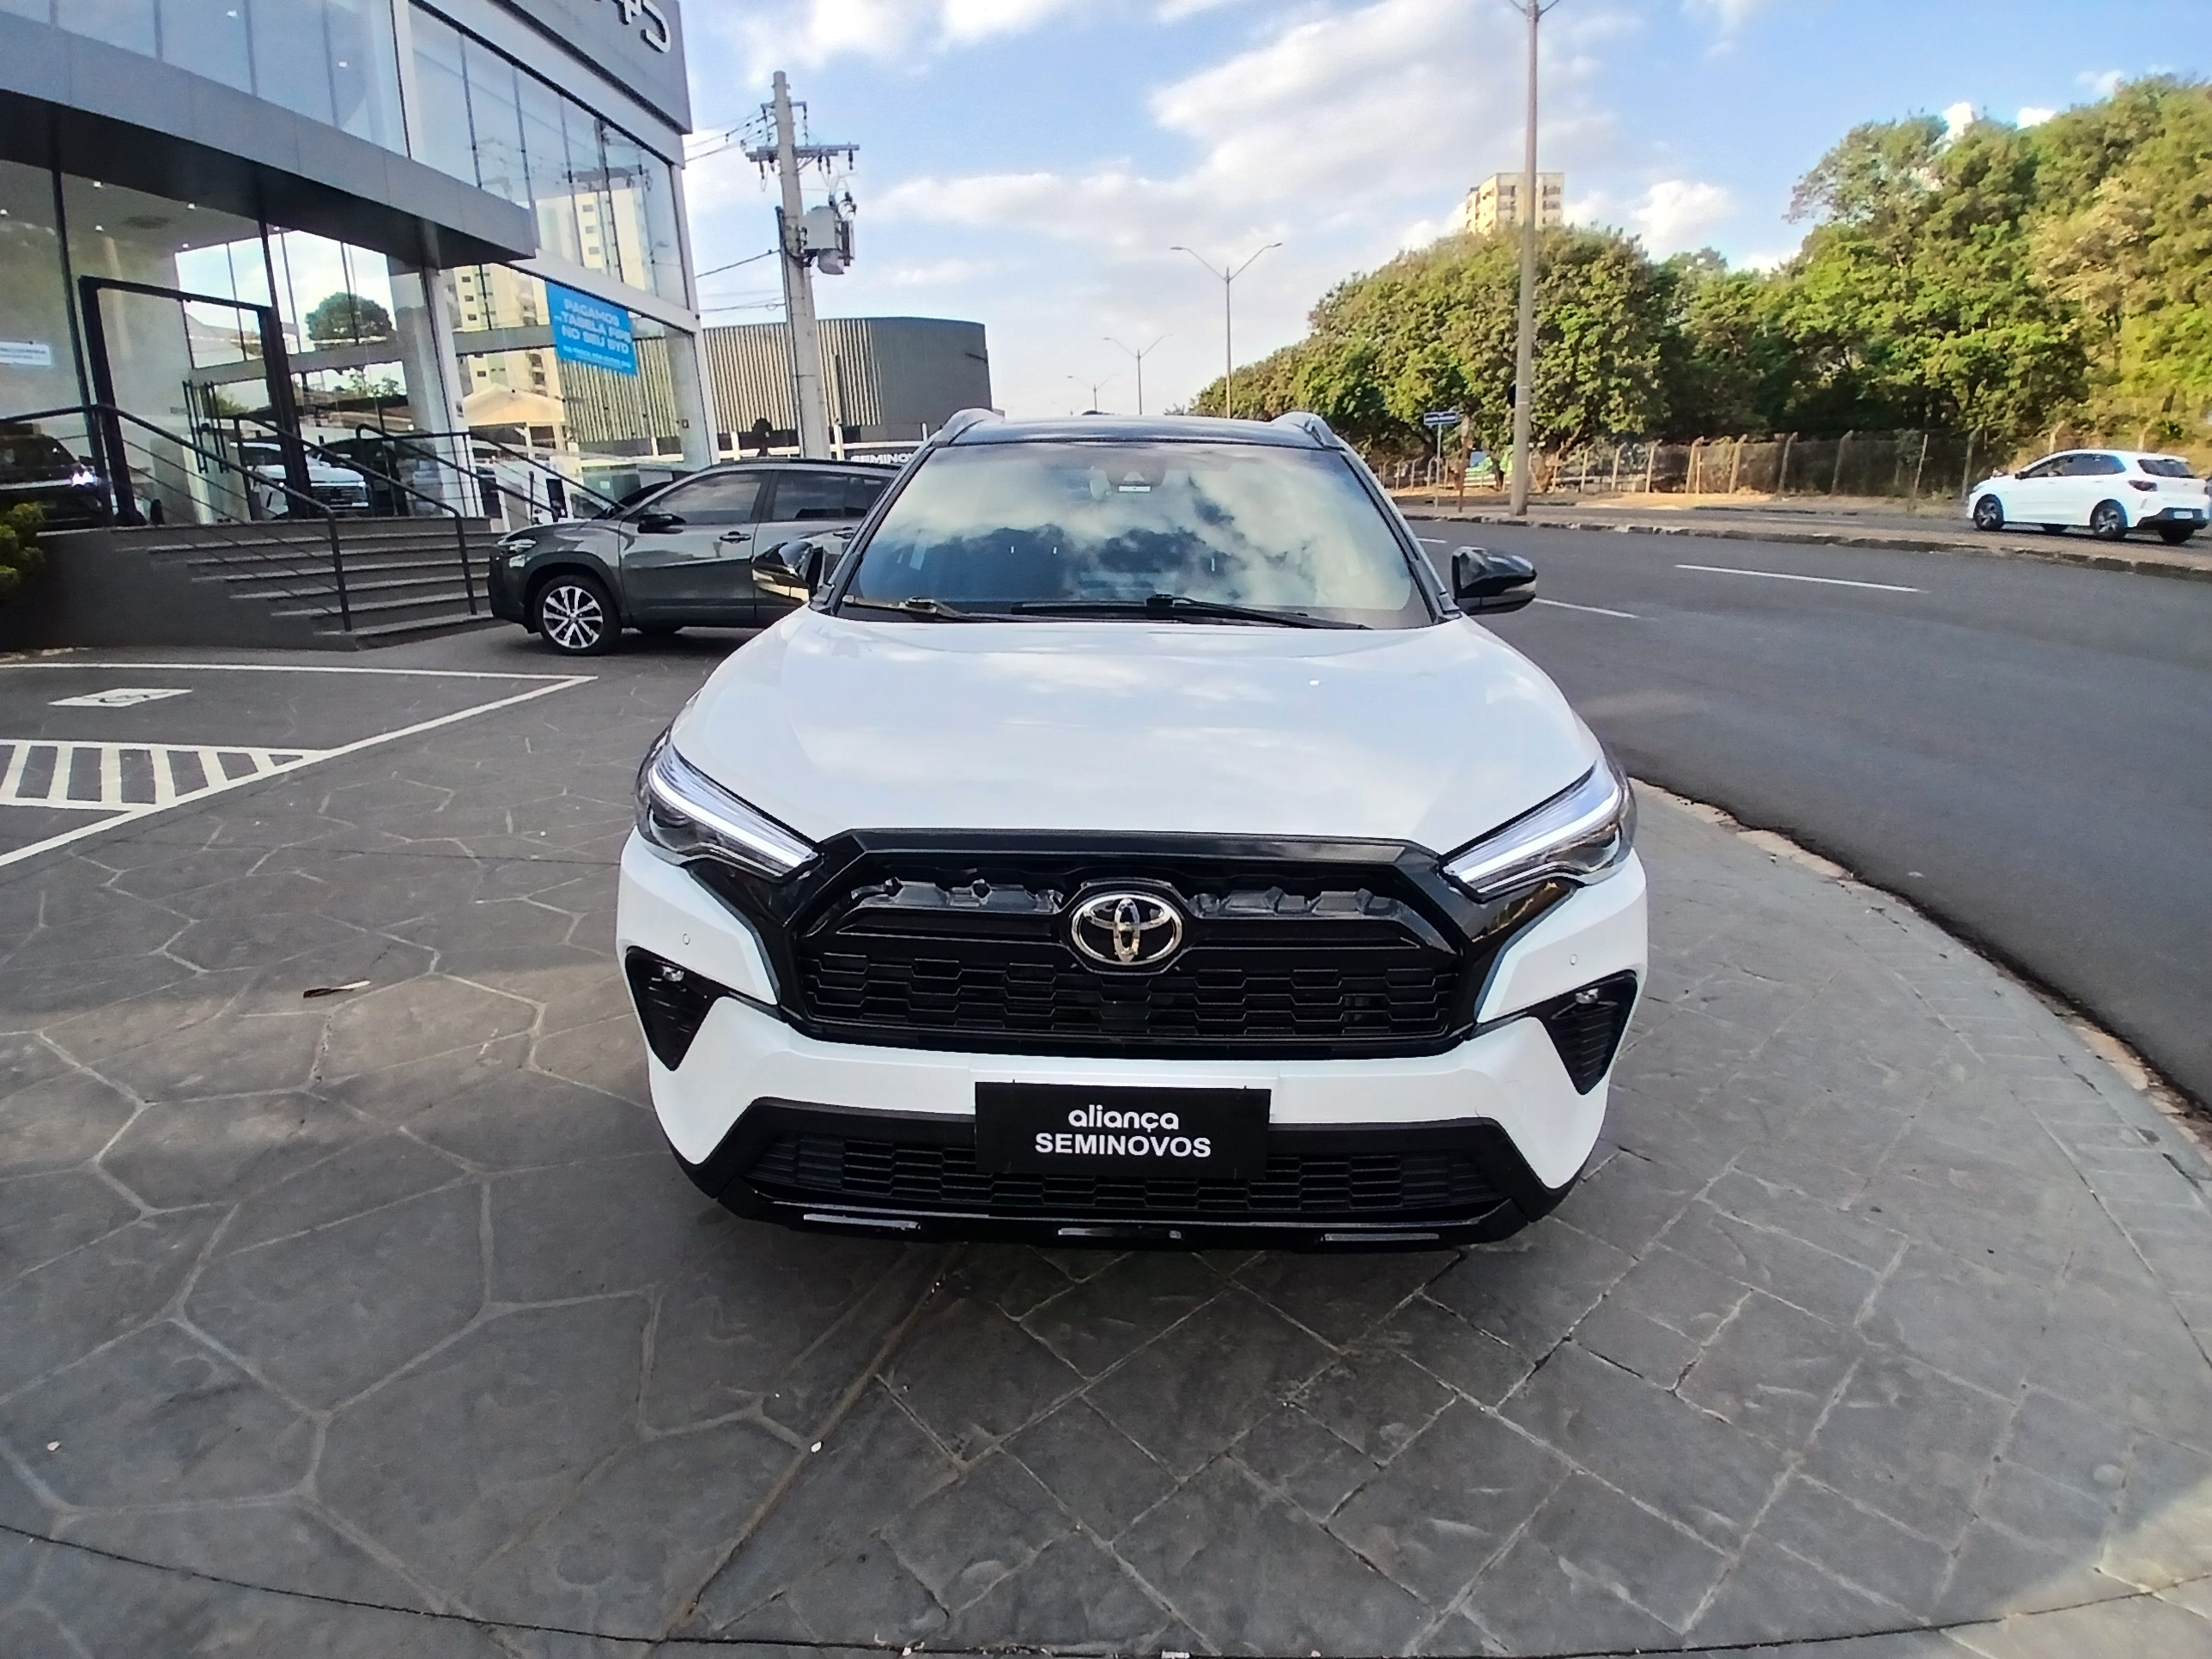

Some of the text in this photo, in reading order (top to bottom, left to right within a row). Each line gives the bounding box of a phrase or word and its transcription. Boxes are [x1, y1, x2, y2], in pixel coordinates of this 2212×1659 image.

[561, 311, 607, 336] TABELA
[563, 298, 620, 327] PAGAMOS
[562, 325, 580, 340] NO
[582, 331, 605, 347] SEU
[1068, 1104, 1179, 1133] aliança
[1035, 1132, 1212, 1158] SEMINOVOS
